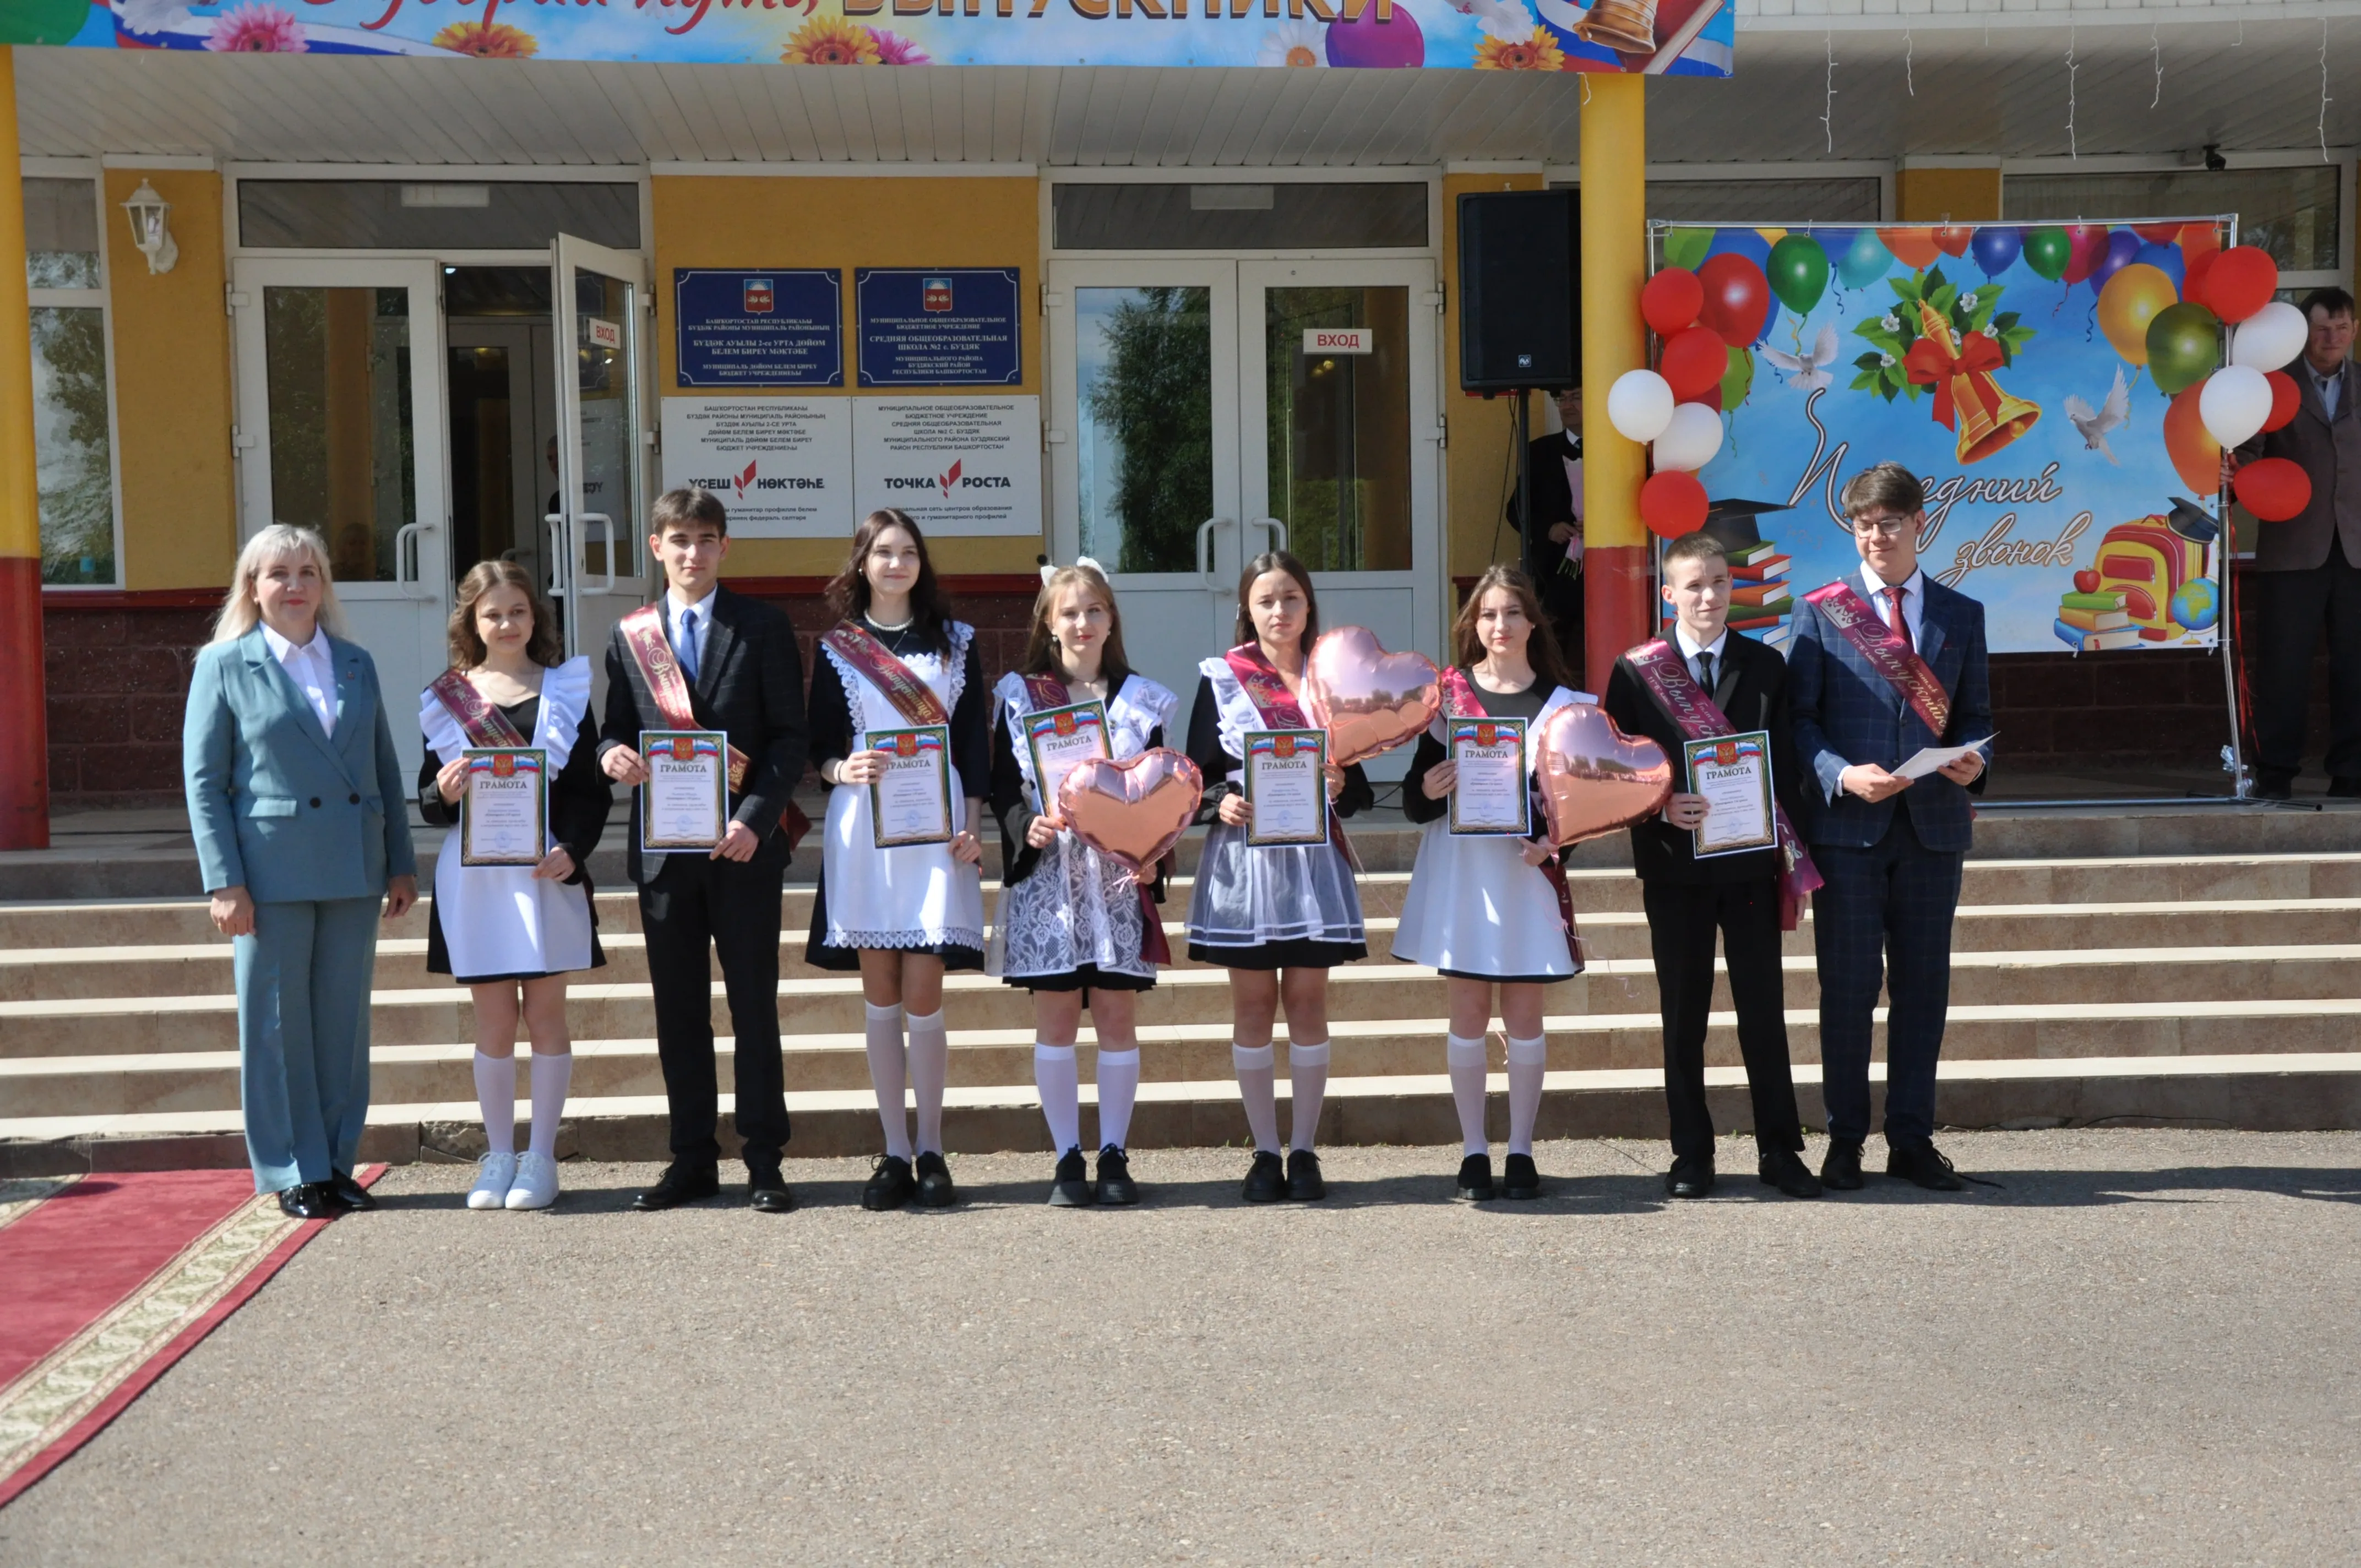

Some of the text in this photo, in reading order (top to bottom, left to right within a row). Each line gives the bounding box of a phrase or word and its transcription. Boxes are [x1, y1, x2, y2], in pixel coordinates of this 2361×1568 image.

[596, 325, 616, 344] ВХОД
[1317, 334, 1359, 348] ВХОД
[1788, 387, 2063, 554] Педний
[758, 478, 825, 489] НӨКТӘҺЕ
[884, 477, 1011, 489] ТОЧКА РОСТА
[1932, 510, 2093, 589] звонок
[1854, 623, 1947, 727] Выпускник
[1651, 662, 1716, 739] Выпуск
[1047, 735, 1092, 751] ГРАМОТА
[1465, 750, 1509, 759] ГРАМОТА
[660, 764, 707, 773] ГРАМОТА
[1262, 761, 1307, 770] ГРАМОТА
[1706, 766, 1752, 780] ГРАМОТА
[480, 781, 527, 789] ГРАМОТА
